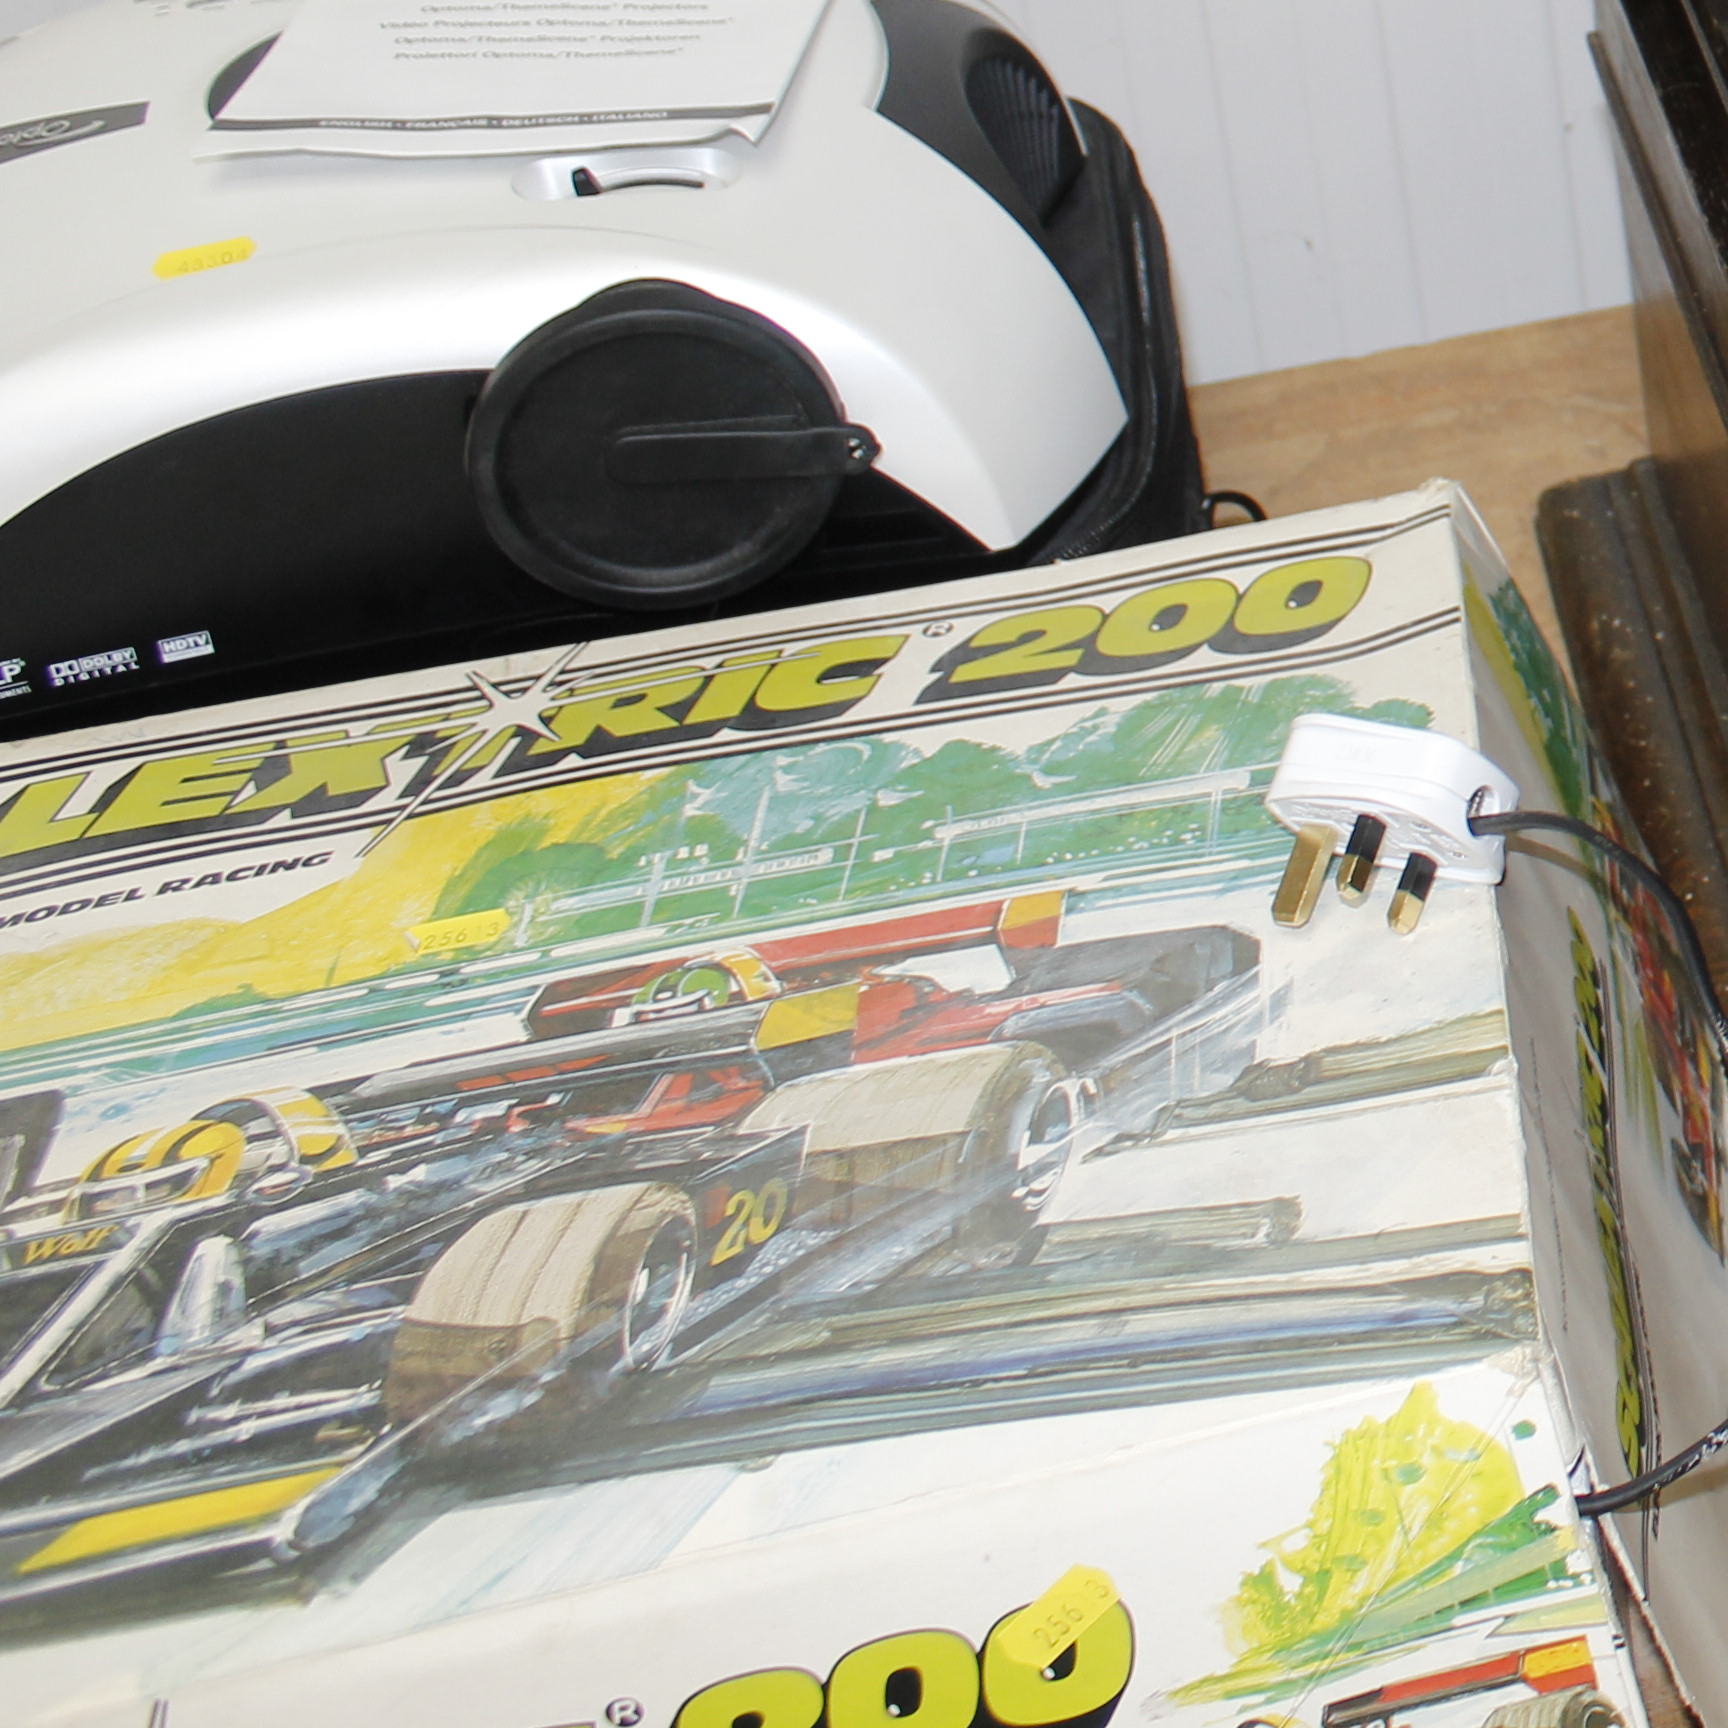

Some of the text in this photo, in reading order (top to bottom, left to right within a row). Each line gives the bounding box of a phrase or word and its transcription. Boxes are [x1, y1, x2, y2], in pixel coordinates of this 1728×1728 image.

[163, 633, 207, 654] HDTV
[916, 555, 1374, 703] 200
[54, 663, 140, 687] DIGITAL
[82, 649, 134, 669] DOLBY
[154, 850, 335, 897] RACING
[708, 1176, 789, 1267] 20
[23, 1223, 121, 1265] Wolf
